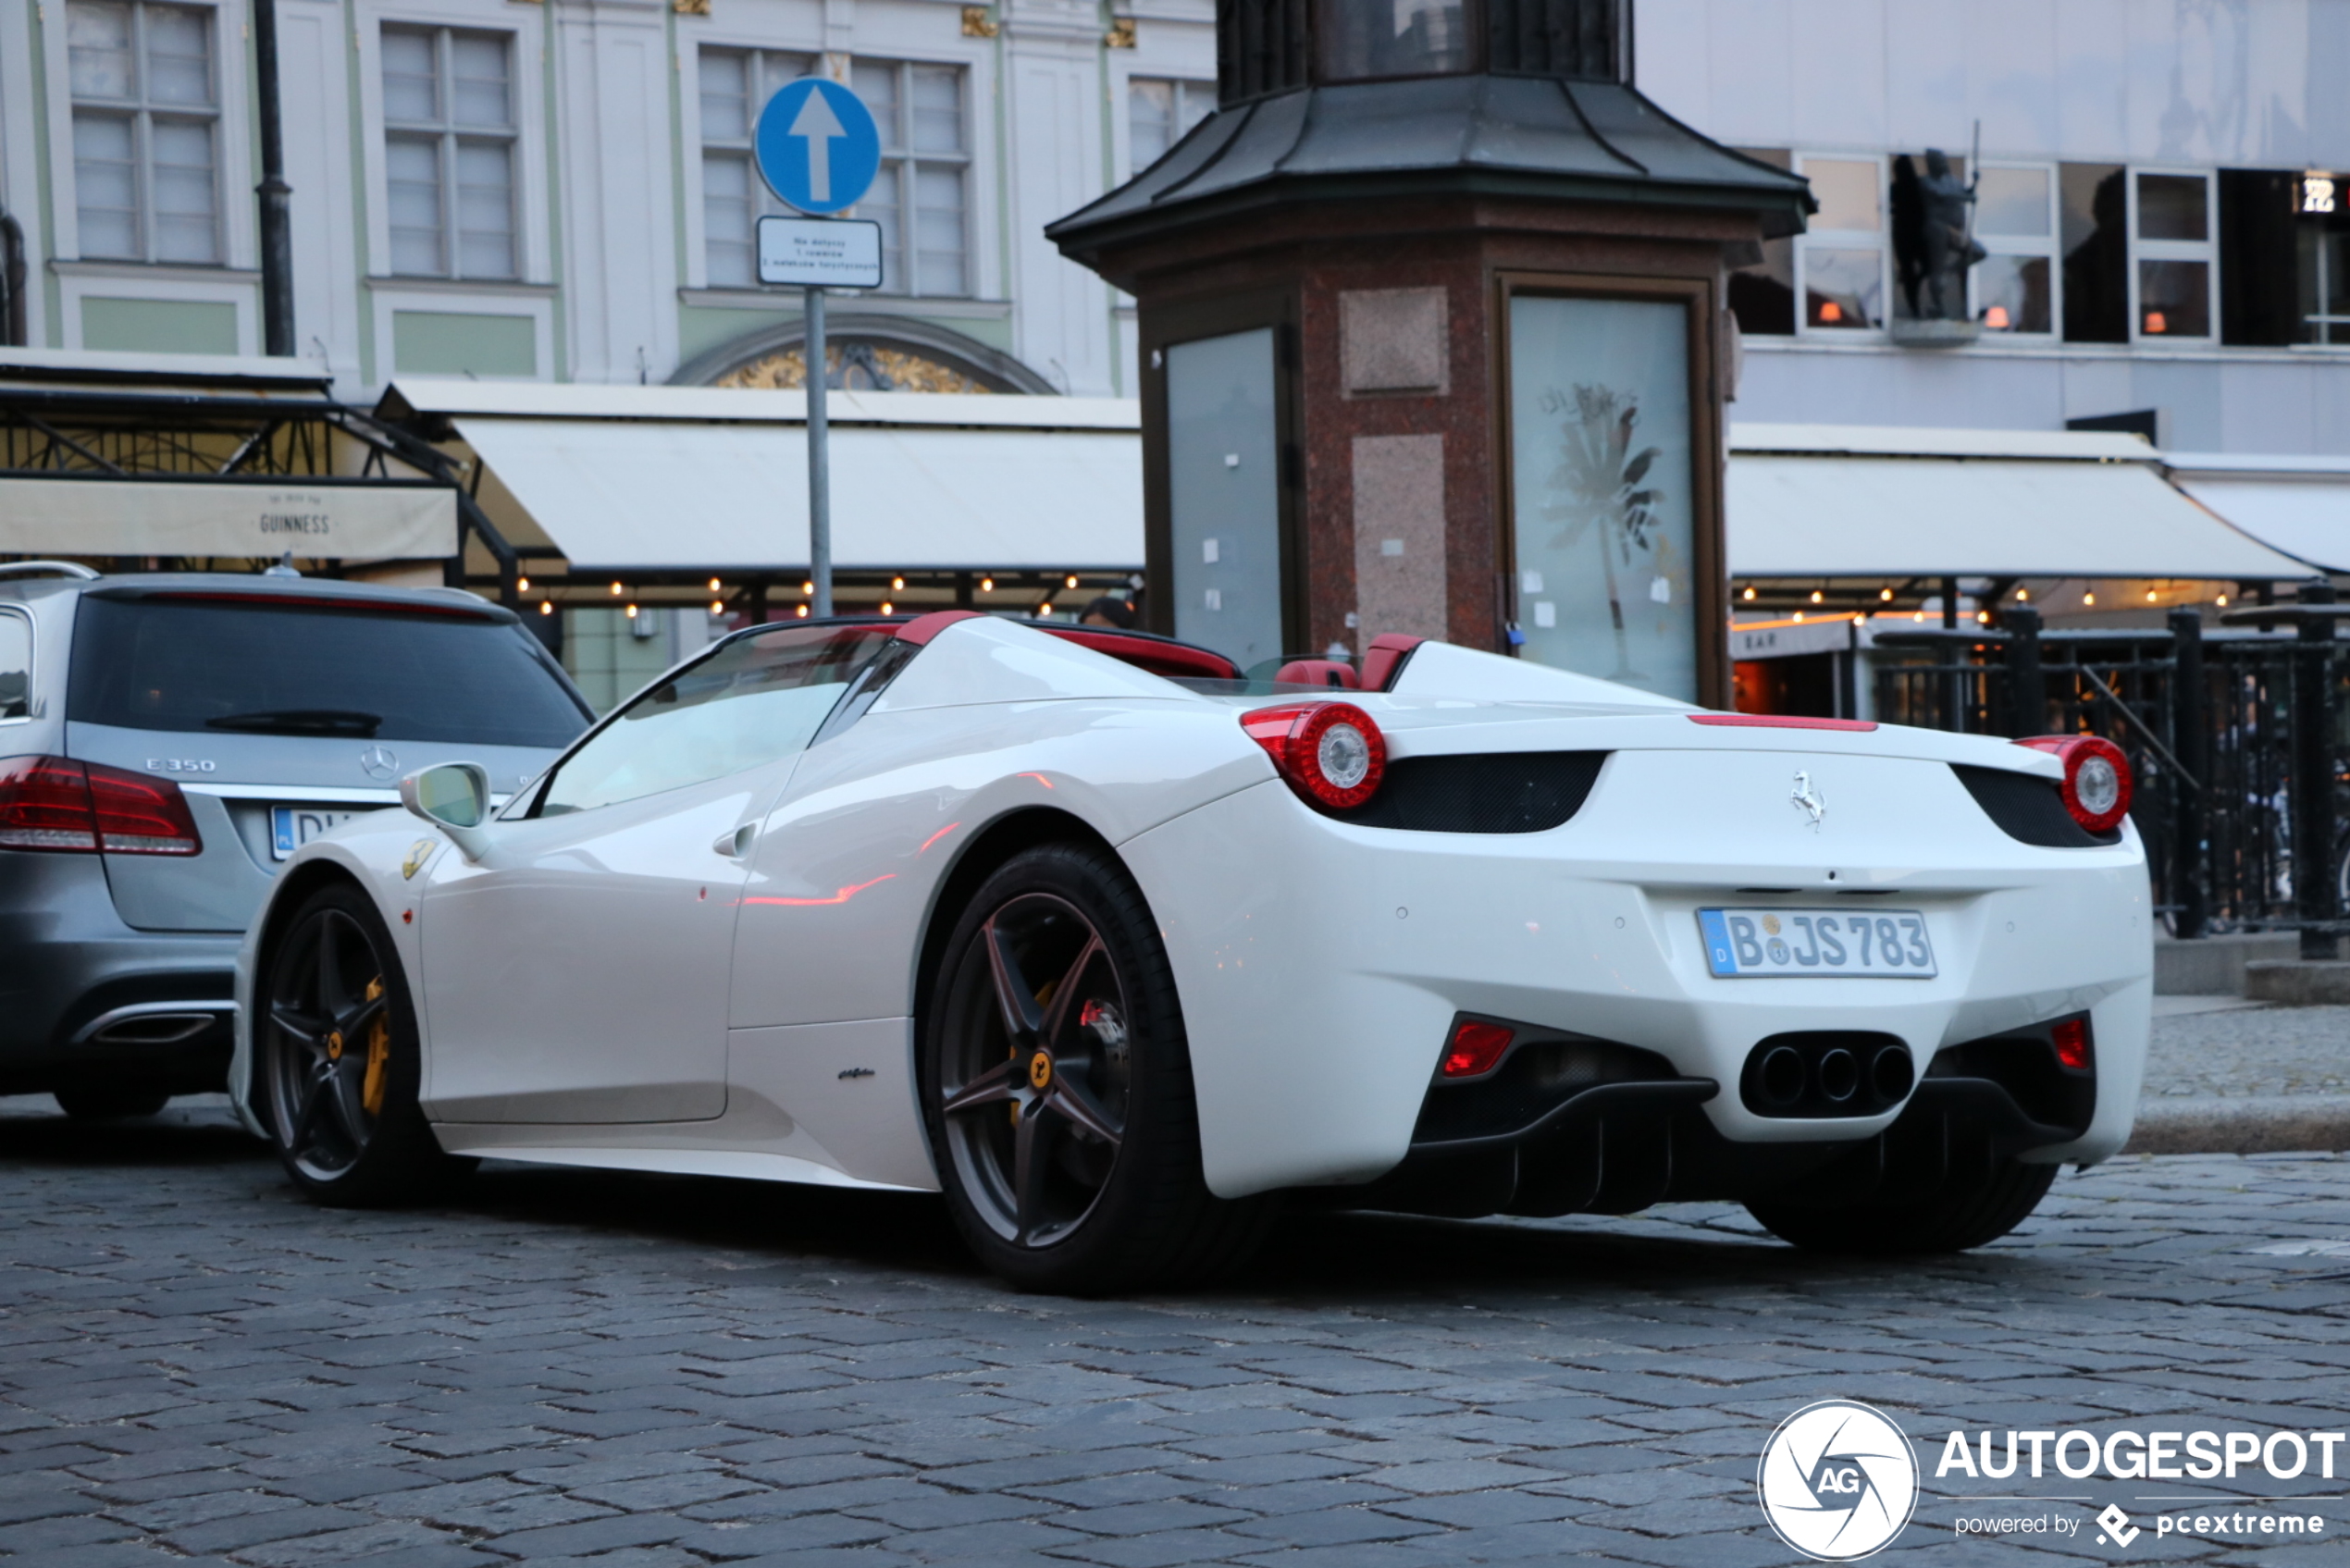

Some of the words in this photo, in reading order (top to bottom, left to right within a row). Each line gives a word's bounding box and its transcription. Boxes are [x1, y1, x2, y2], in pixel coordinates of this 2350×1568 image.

[261, 513, 329, 534] GUINNESS
[146, 759, 161, 771] E
[167, 759, 216, 772] 350
[1716, 948, 1727, 963] D
